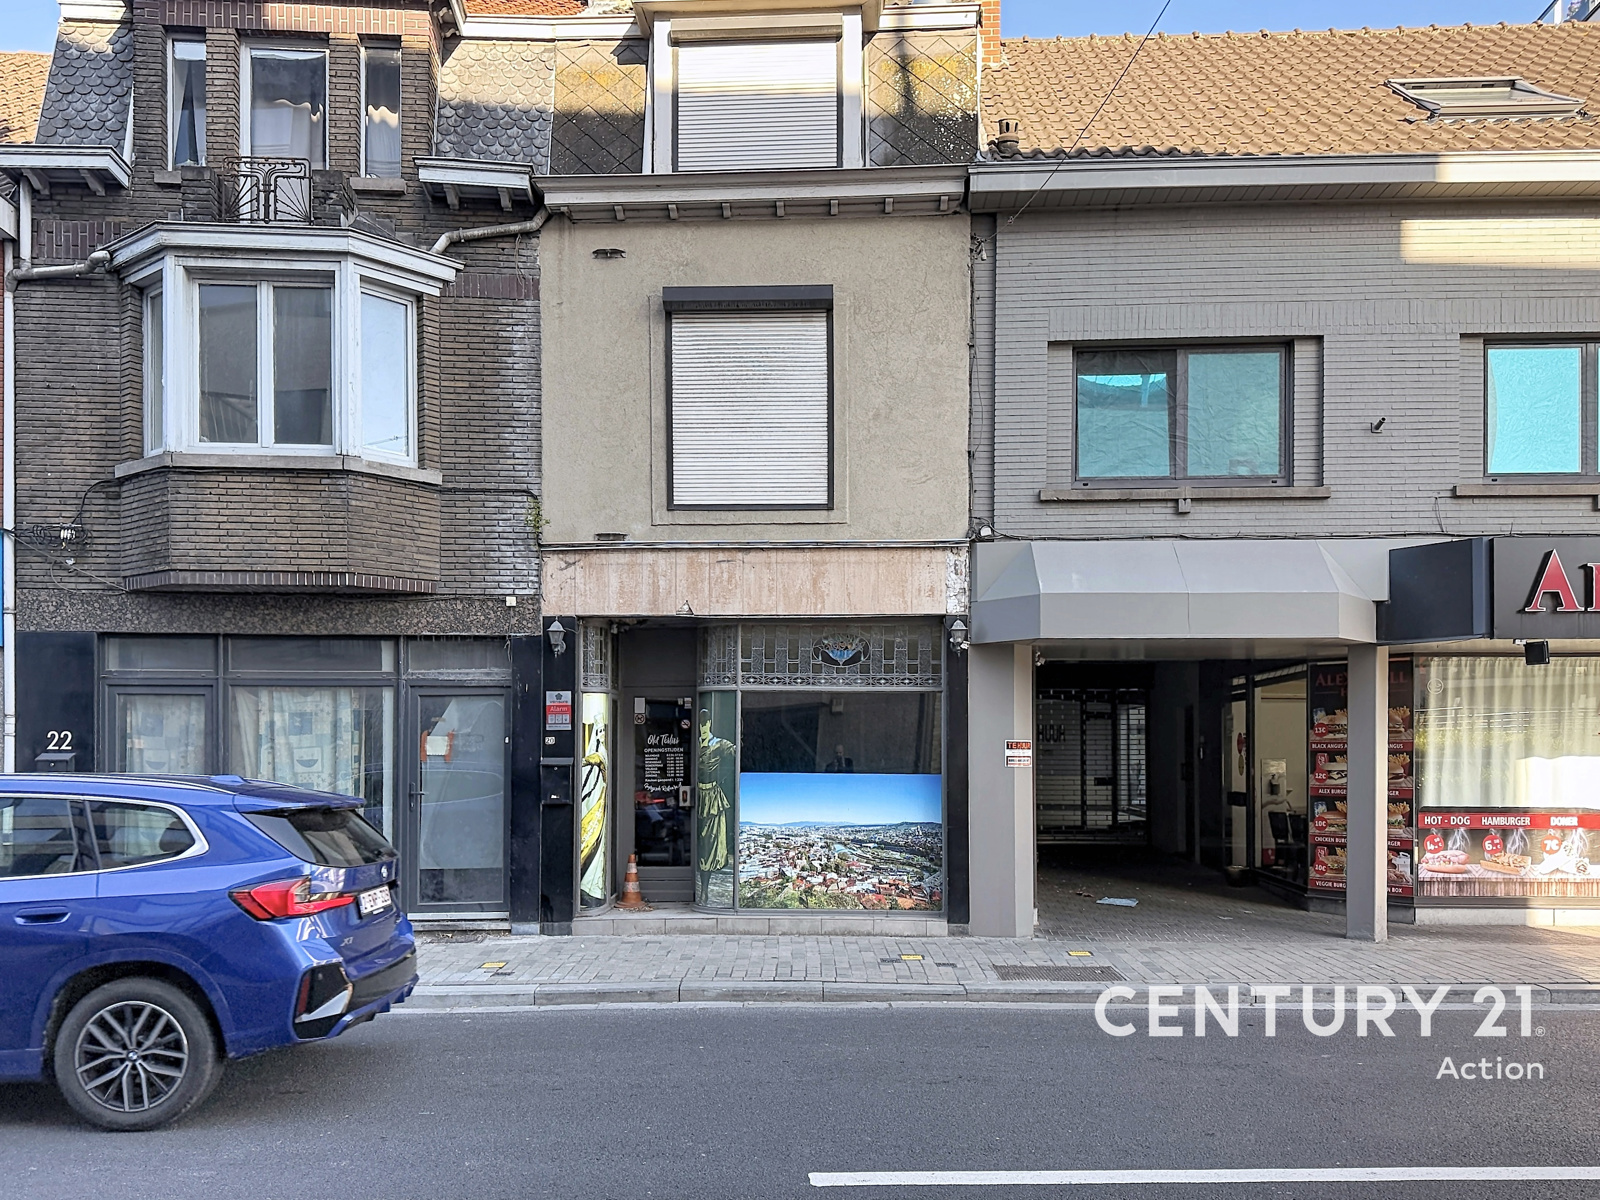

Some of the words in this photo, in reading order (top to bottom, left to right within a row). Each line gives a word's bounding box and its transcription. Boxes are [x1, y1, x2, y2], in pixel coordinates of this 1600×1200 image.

[47, 731, 72, 750] 22
[1424, 816, 1443, 825] HOT
[1450, 816, 1471, 825] DOG
[1481, 816, 1531, 826] HAMBURGER
